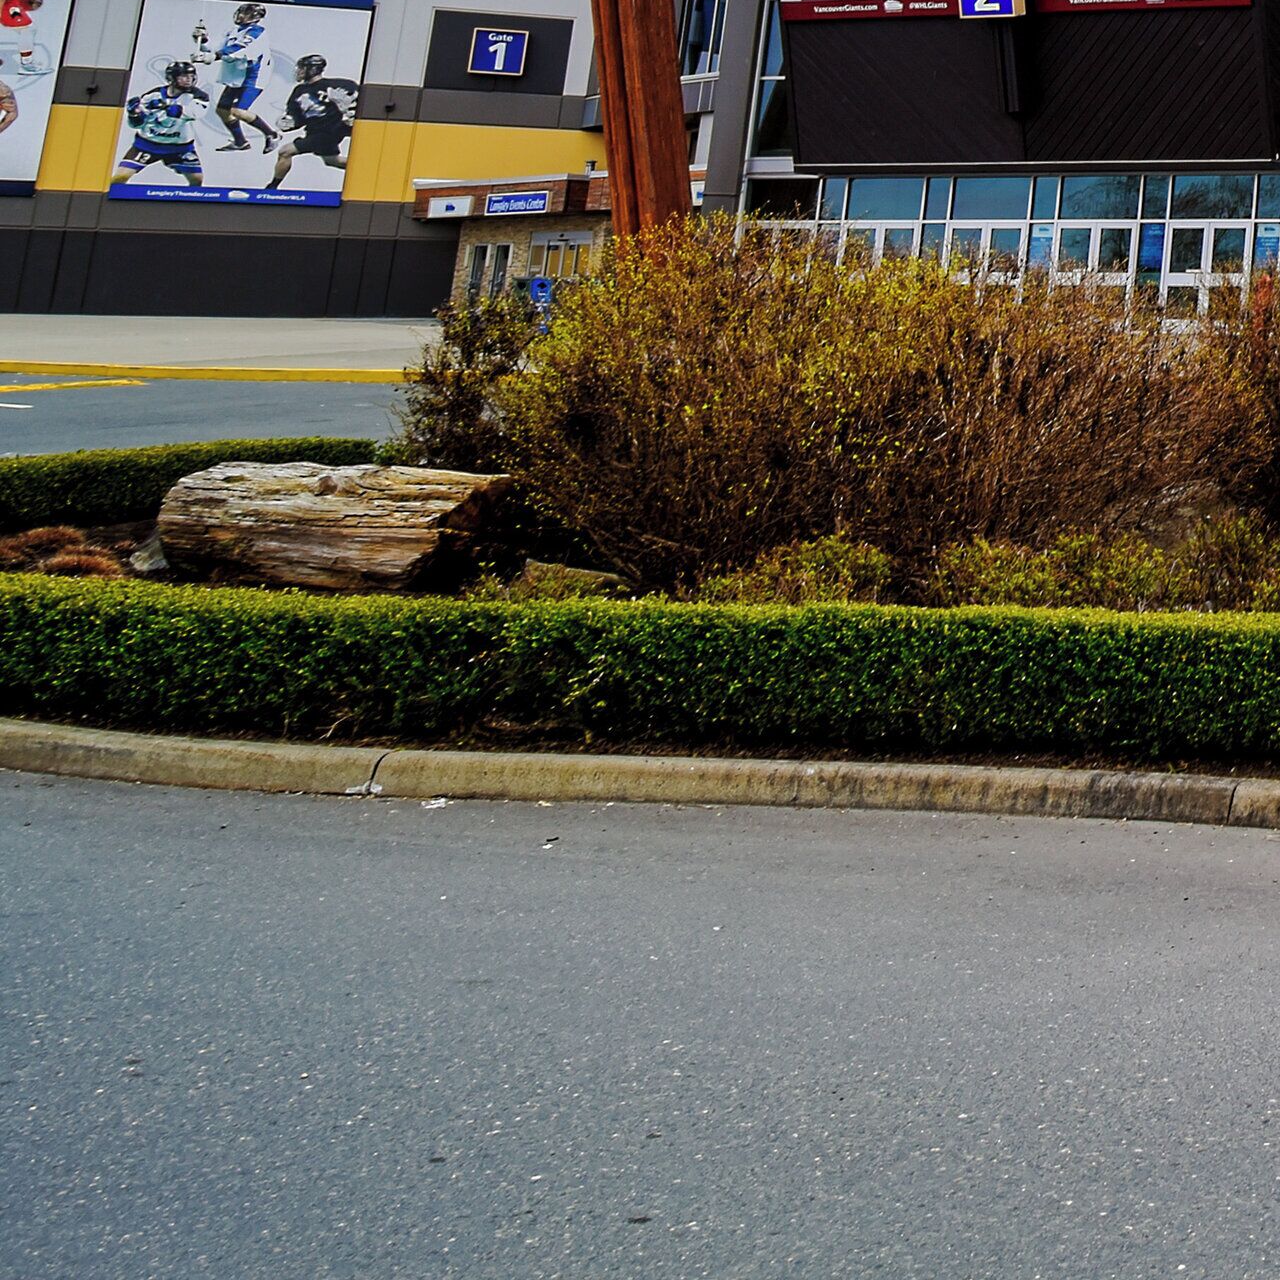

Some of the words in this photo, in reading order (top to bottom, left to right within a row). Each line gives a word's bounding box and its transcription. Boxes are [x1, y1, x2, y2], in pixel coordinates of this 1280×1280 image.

[814, 4, 878, 13] VancouverGiants.com
[909, 2, 948, 10] @WHLGiants
[488, 32, 514, 42] Gate
[487, 42, 507, 70] 1
[146, 189, 220, 198] LangleyThunder.com
